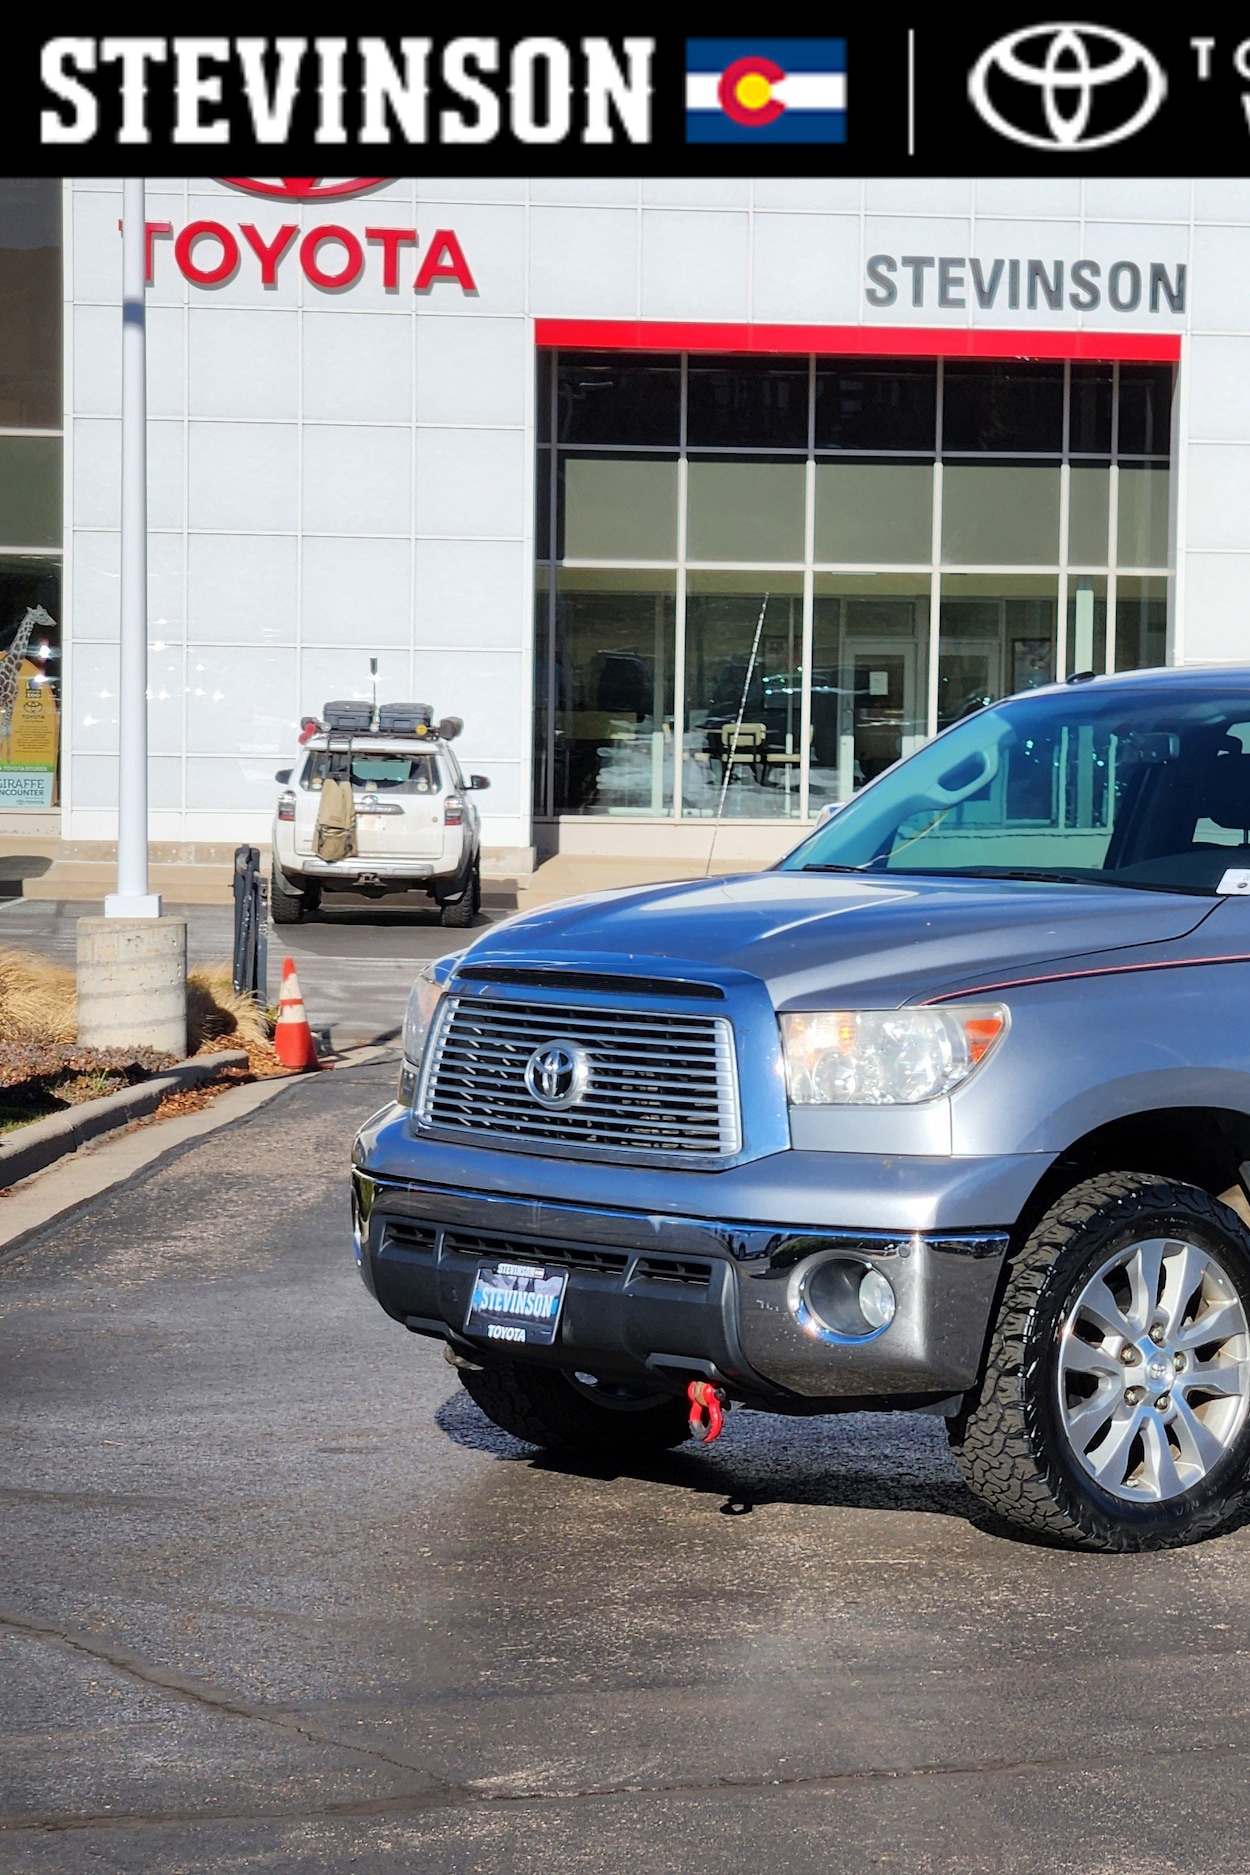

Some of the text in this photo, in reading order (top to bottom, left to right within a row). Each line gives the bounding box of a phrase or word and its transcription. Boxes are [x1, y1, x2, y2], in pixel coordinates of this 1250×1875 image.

[118, 219, 477, 293] TOYOTA
[864, 254, 1188, 315] STEVINSON
[480, 1287, 554, 1318] STEVINSON
[487, 1324, 526, 1342] TOYOTA
